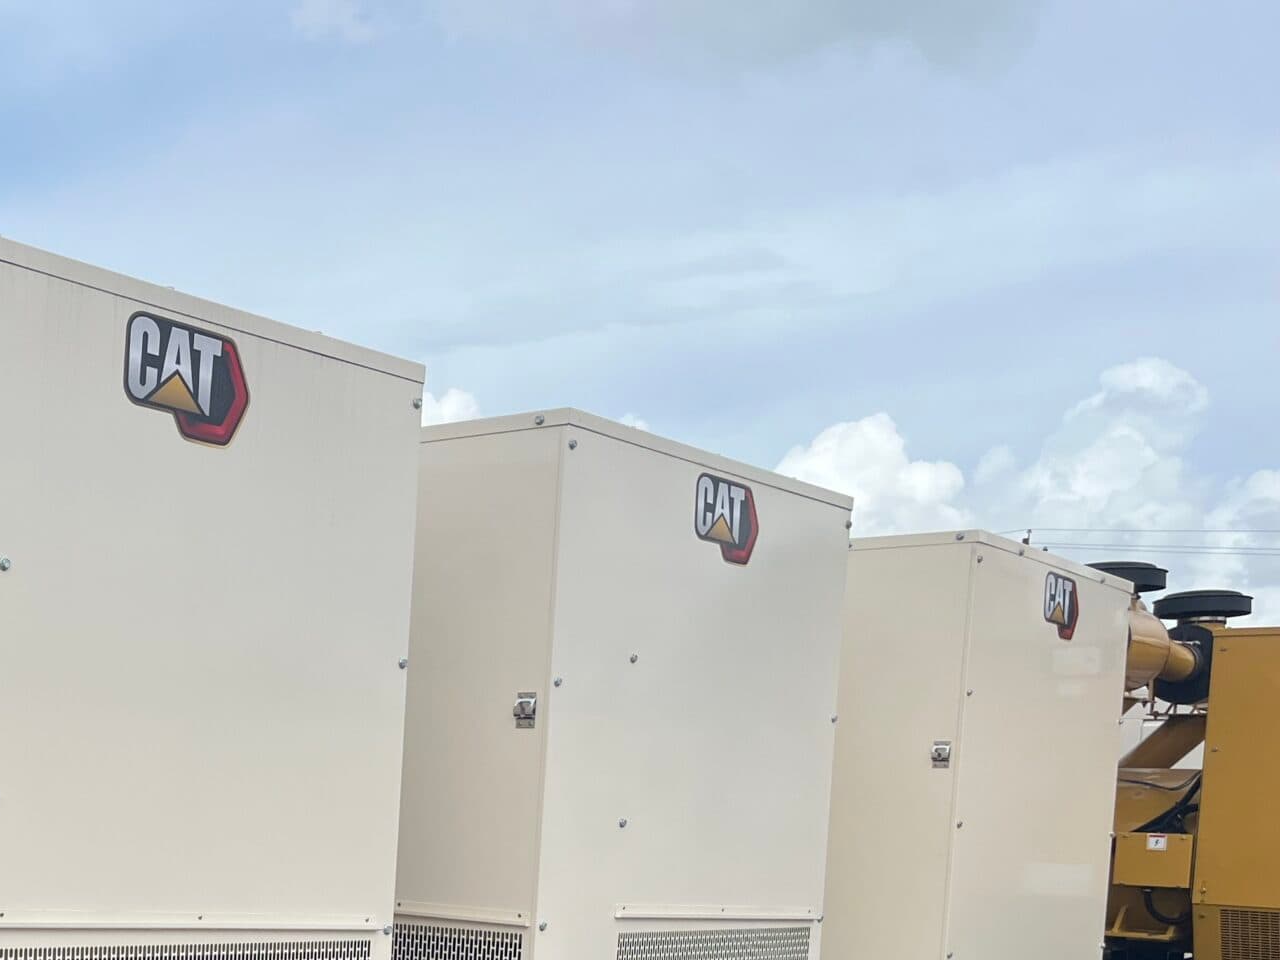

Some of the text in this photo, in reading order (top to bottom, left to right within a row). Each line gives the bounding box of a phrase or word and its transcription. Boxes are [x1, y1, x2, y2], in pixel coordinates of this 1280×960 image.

[127, 315, 223, 417] CAT
[696, 476, 746, 545] CAT
[1044, 573, 1073, 625] CAT
